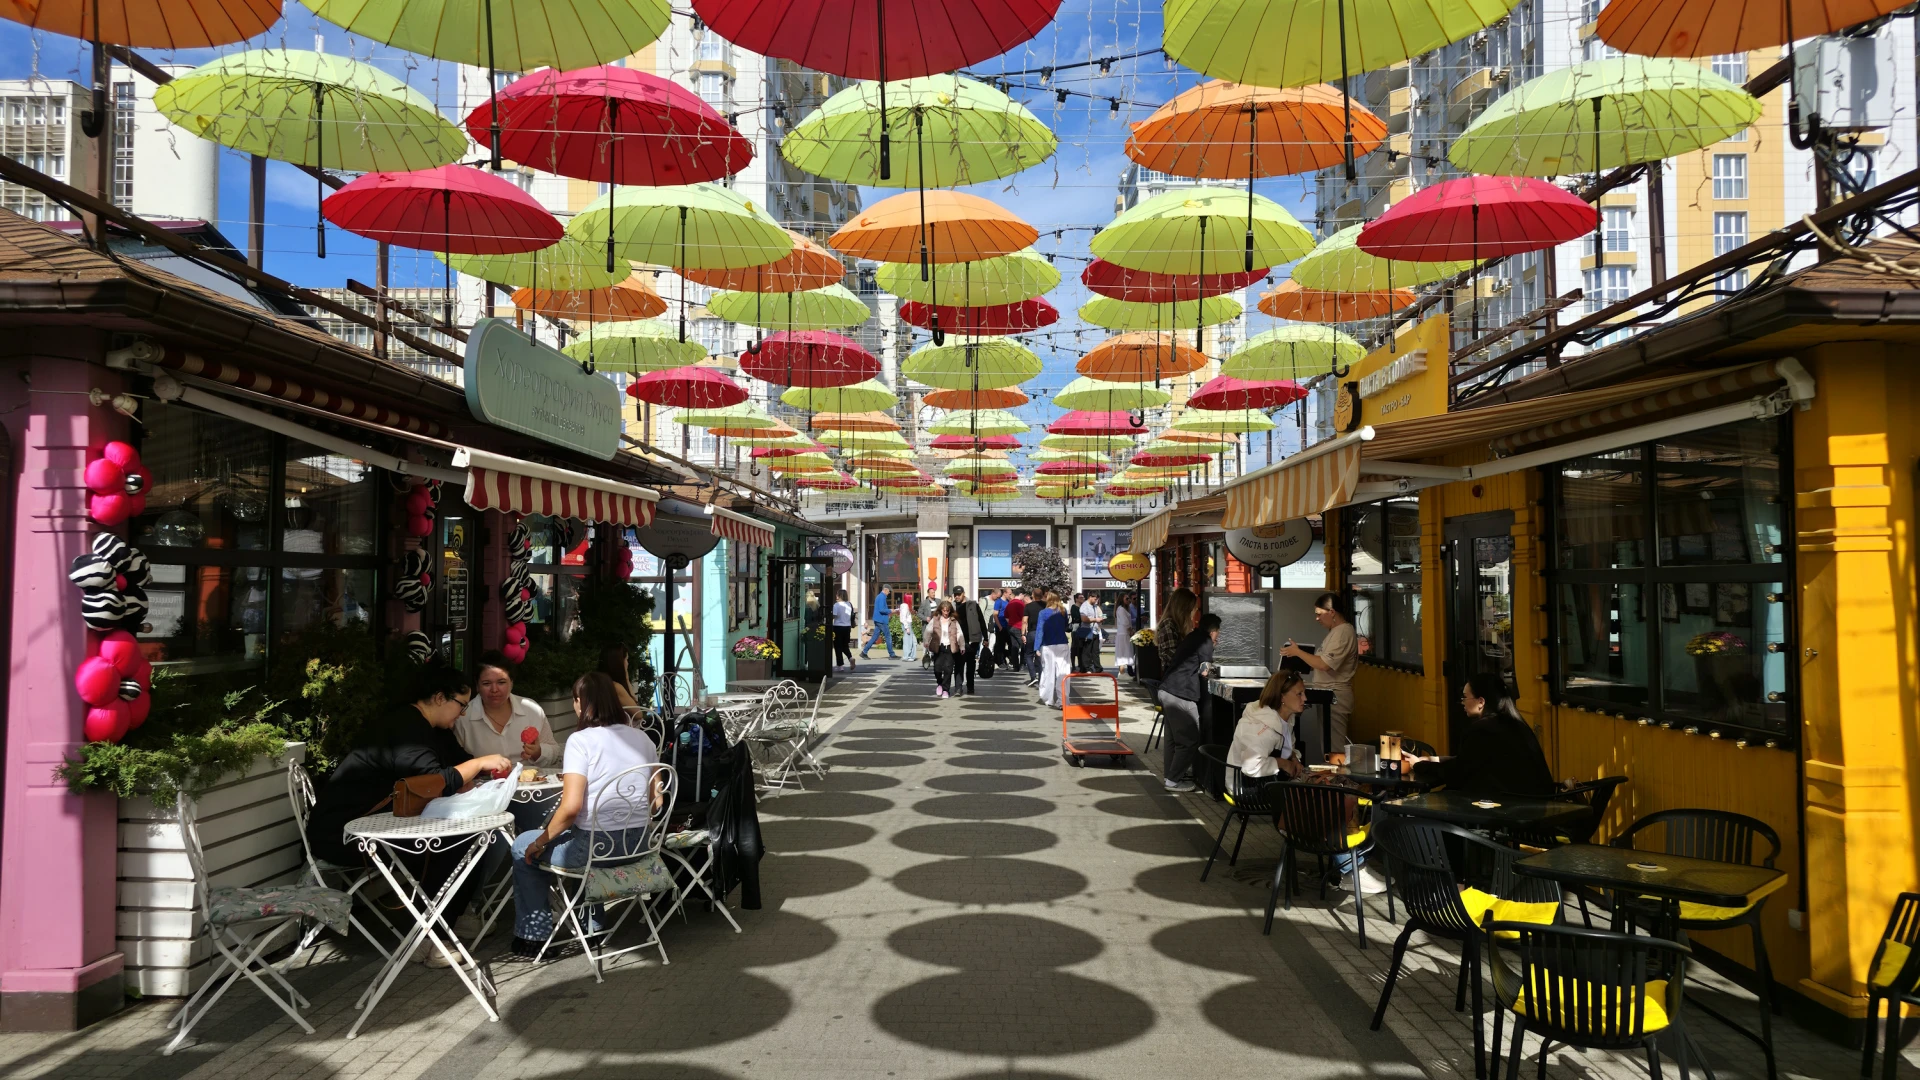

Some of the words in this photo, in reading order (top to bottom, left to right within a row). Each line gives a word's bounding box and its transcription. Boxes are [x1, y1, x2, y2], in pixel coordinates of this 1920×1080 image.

[1239, 536, 1261, 550] ПАСТА
[1263, 542, 1269, 550] В
[1270, 535, 1299, 550] ГОЛОВЕ
[668, 555, 687, 567] 29
[1114, 562, 1145, 570] ПЕЧКА
[1260, 563, 1279, 575] 22
[1105, 580, 1127, 589] ВХОД
